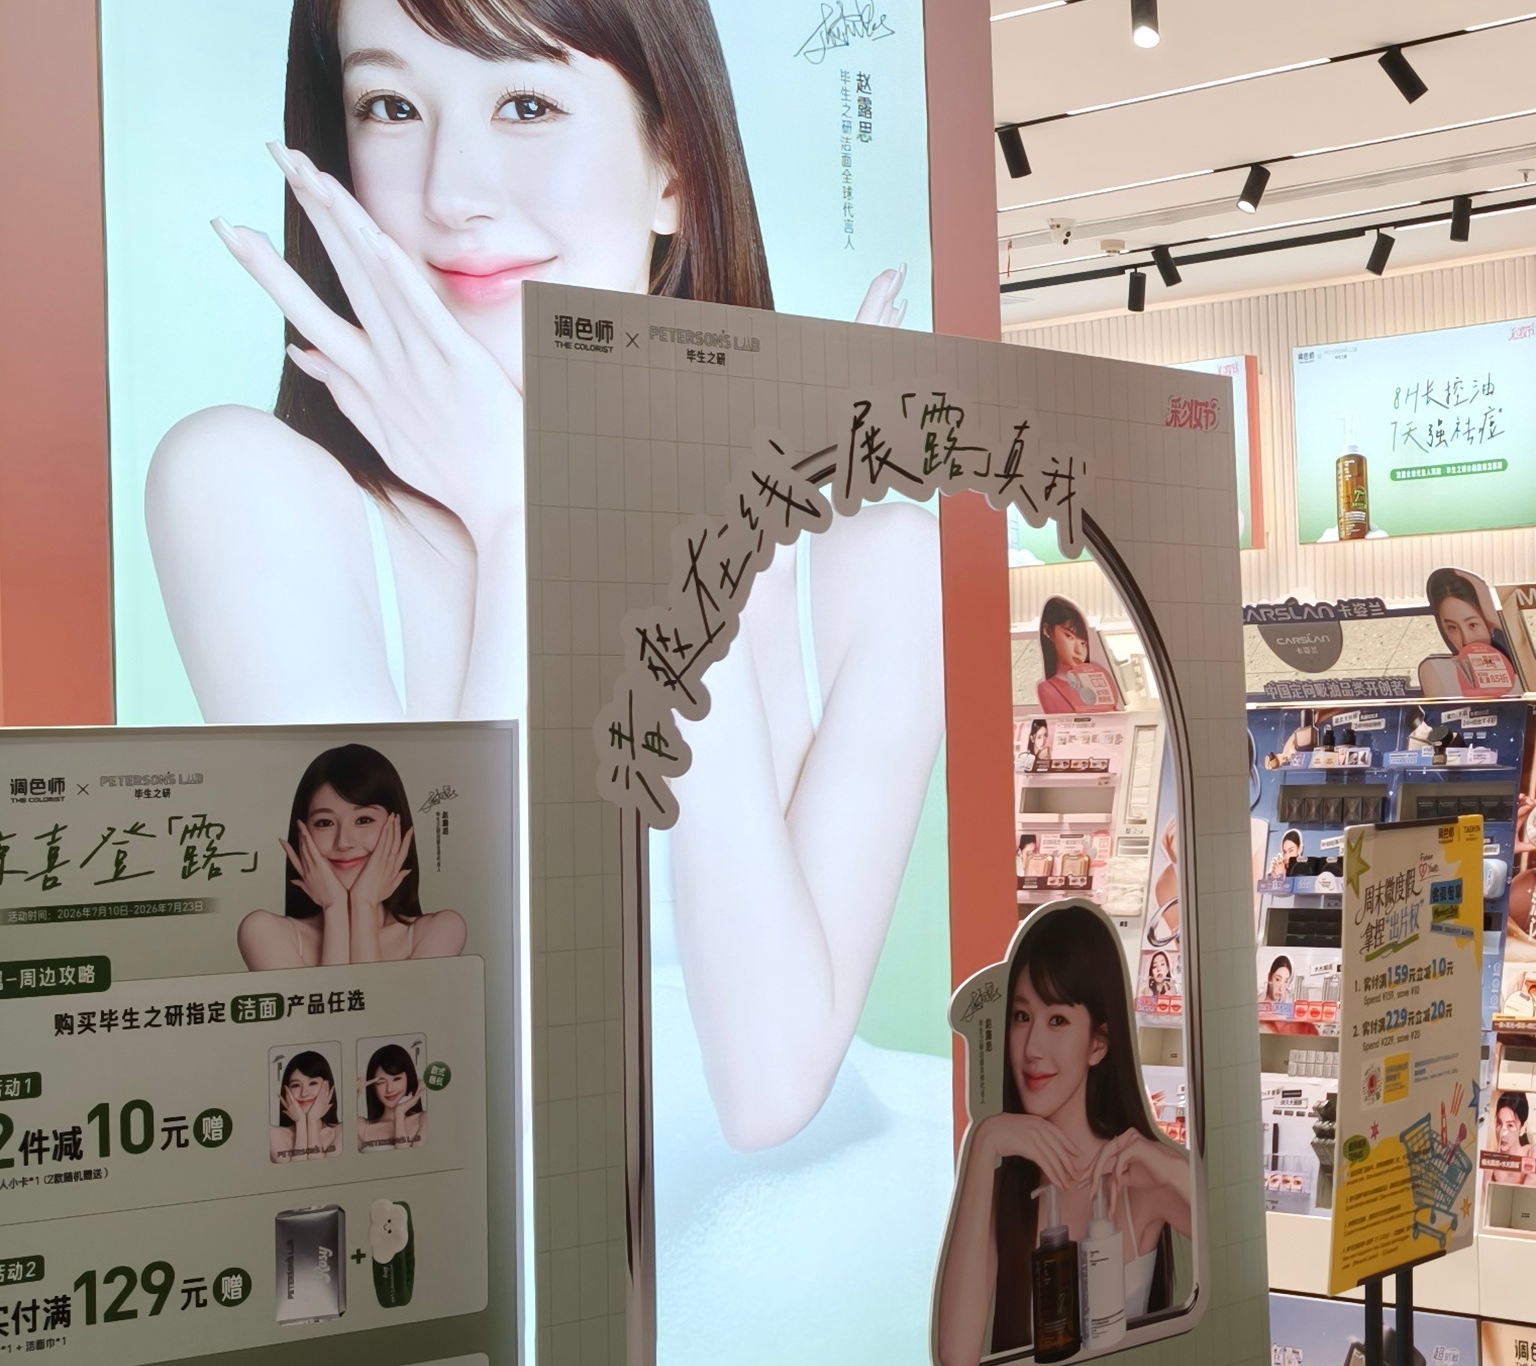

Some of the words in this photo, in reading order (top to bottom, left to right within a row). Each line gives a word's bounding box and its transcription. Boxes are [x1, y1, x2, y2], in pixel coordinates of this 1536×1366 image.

[554, 315, 613, 344] 调色师
[555, 340, 572, 350] THE
[574, 343, 613, 354] COLORIST
[686, 349, 726, 366] 毕生之研
[1242, 599, 1335, 622] ARSLAN
[1338, 600, 1385, 618] 卡姿兰
[10, 777, 66, 796] 调色师
[134, 788, 171, 800] 毕生之研
